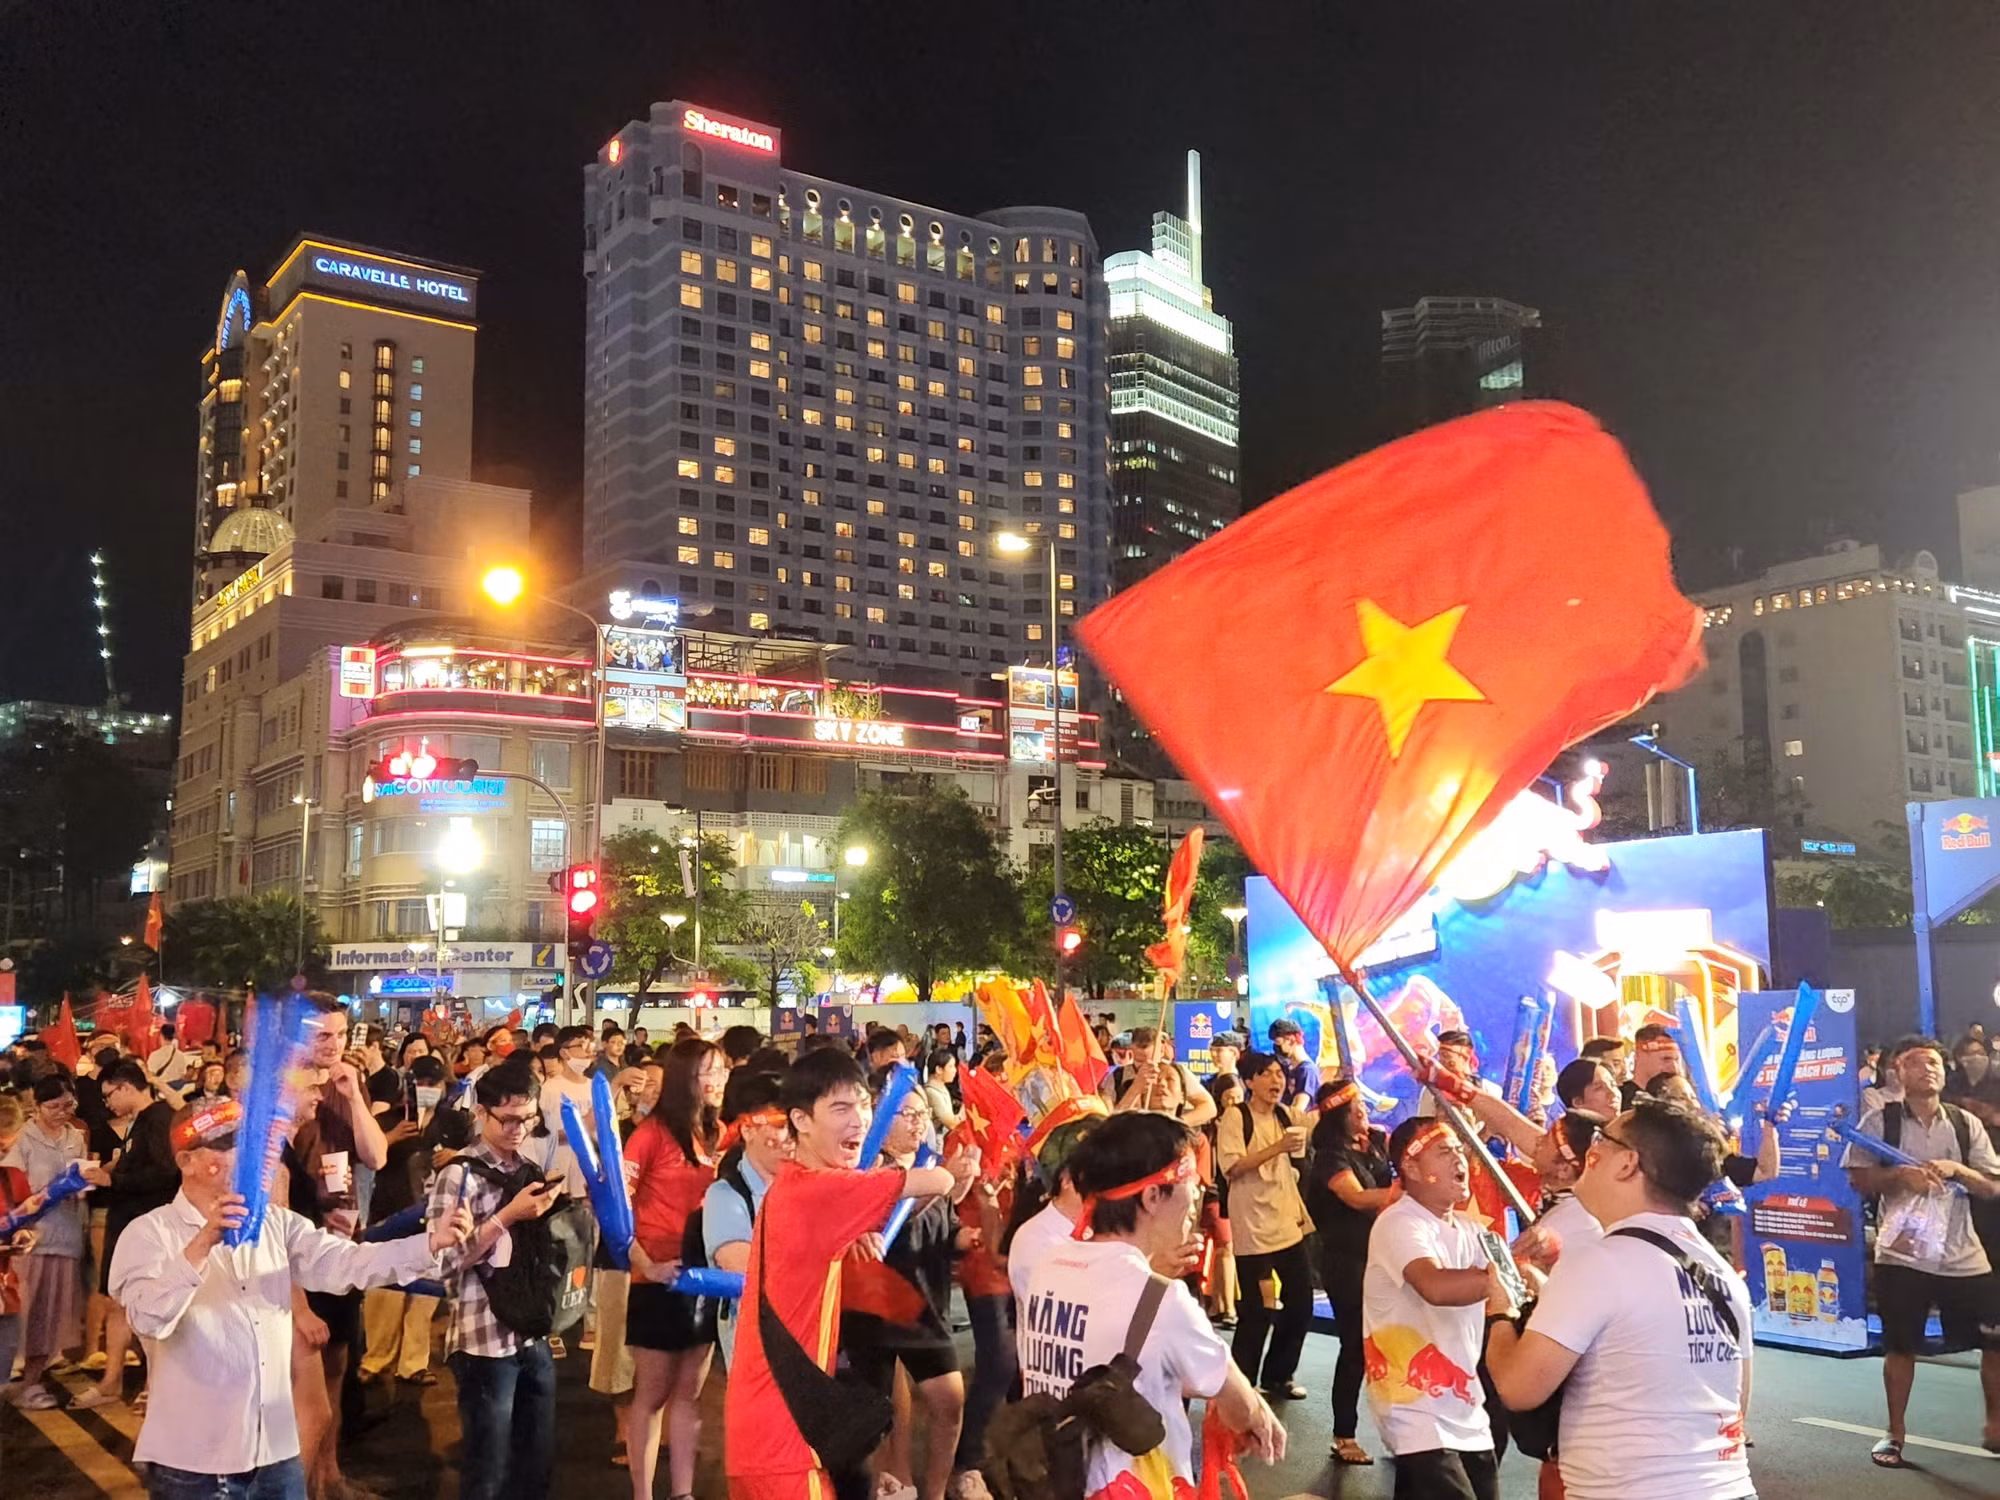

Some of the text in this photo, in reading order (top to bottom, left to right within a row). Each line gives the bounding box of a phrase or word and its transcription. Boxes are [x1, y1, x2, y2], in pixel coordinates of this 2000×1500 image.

[684, 109, 773, 151] Sheraton
[315, 258, 468, 302] CARAVELLE HOTEL
[815, 720, 904, 747] SKY ZONE
[1941, 832, 1990, 850] Red Bull
[336, 950, 438, 965] Information
[1027, 1290, 1089, 1342] NĂNG
[1026, 1336, 1084, 1381] LƯỢNG
[1688, 1338, 1714, 1364] TÍCH
